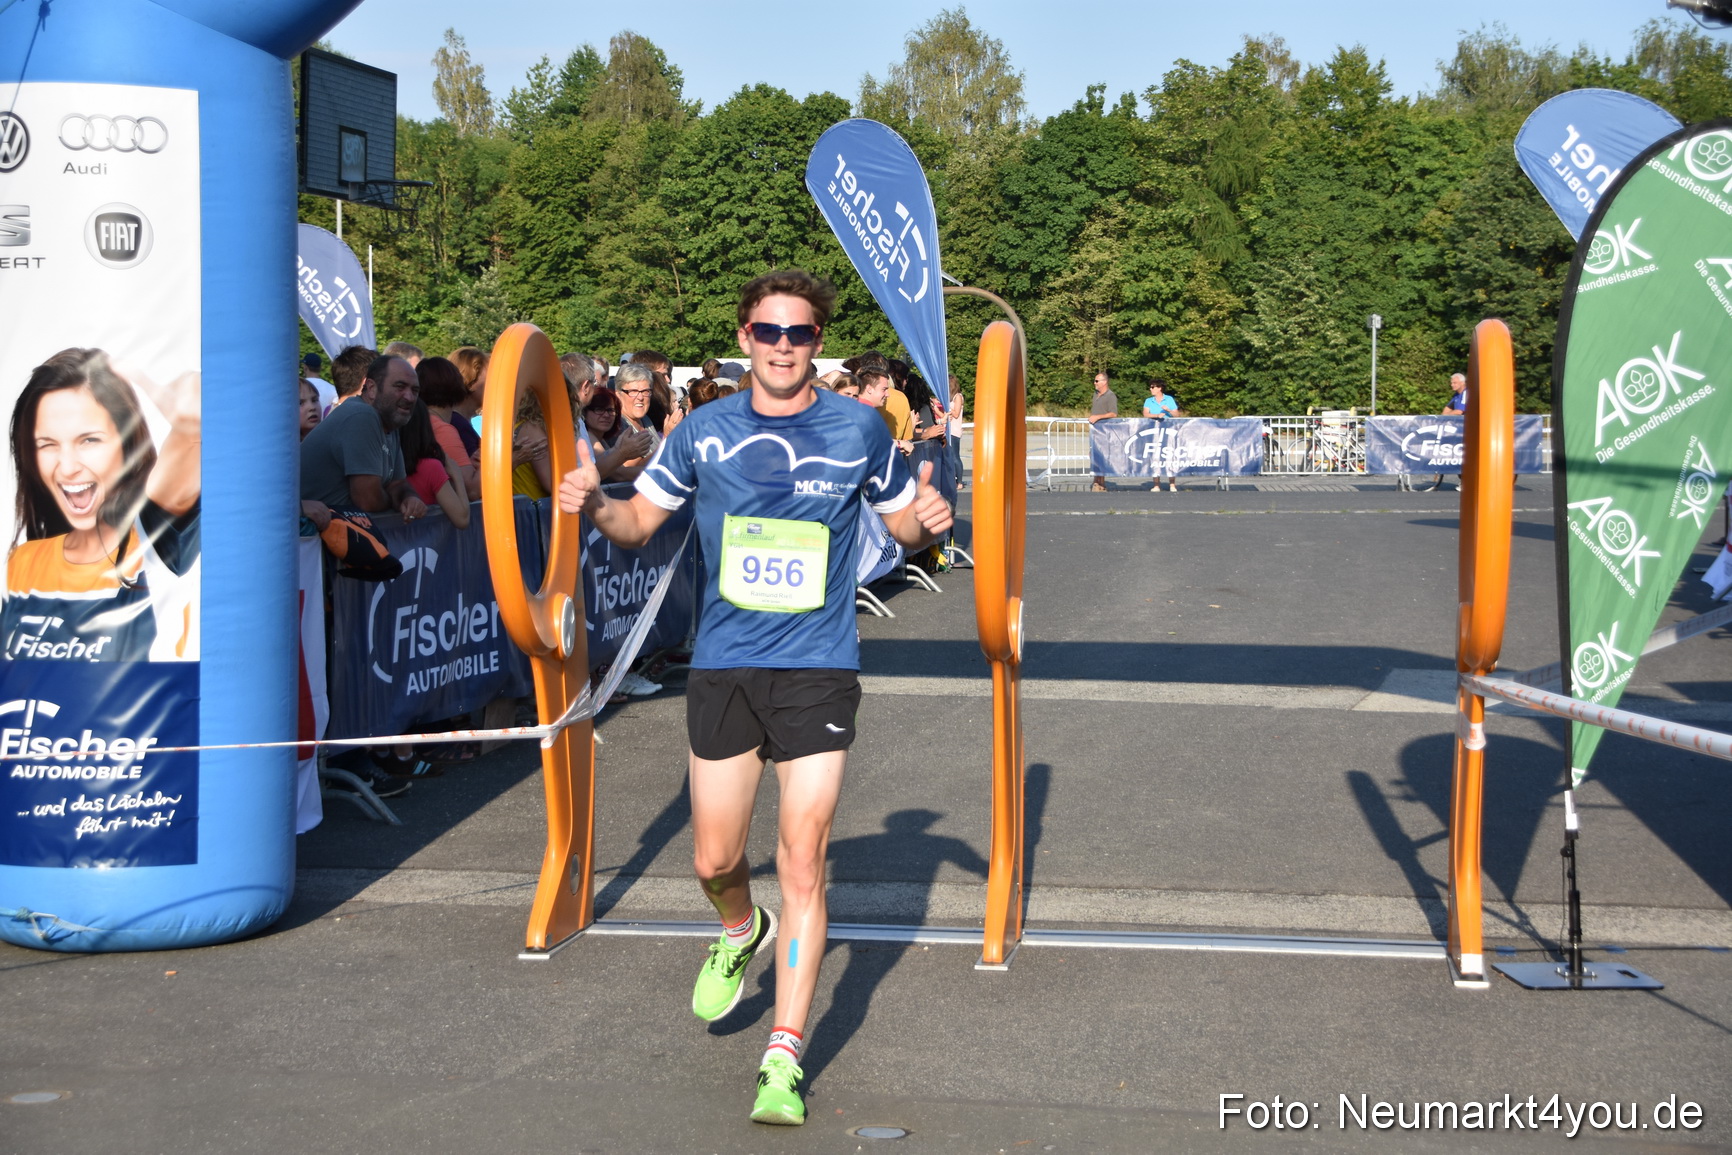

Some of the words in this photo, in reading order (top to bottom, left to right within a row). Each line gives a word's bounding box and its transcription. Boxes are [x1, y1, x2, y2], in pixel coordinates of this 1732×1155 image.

[63, 161, 109, 175] Audi
[1646, 157, 1732, 217] esundheitskas
[100, 222, 138, 251] FIAT
[1575, 263, 1659, 294] sundheitskasse.
[1694, 259, 1709, 278] Die
[1594, 330, 1706, 448] AOK
[1595, 444, 1615, 464] Die
[1614, 383, 1717, 452] Gesundheitskasse.
[1143, 441, 1228, 459] Fischer
[1150, 460, 1220, 468] AUTOMOBILE
[1420, 440, 1464, 457] Fisc
[794, 480, 833, 493] MCM
[1677, 442, 1717, 530] AOK
[1567, 497, 1662, 588] AOK
[742, 555, 804, 588] 956
[1569, 521, 1636, 599] Gesundheitskasse.
[393, 593, 501, 663] Fischer
[14, 634, 111, 662] Fischer
[406, 650, 499, 696] AUTOMOBILE
[0, 729, 158, 761] Fischer
[11, 765, 143, 780] AUTOMOBILE
[34, 798, 67, 817] und
[70, 792, 105, 813] das
[107, 790, 182, 812] Lächeln
[75, 815, 127, 840] fährt
[131, 809, 176, 828] mit!
